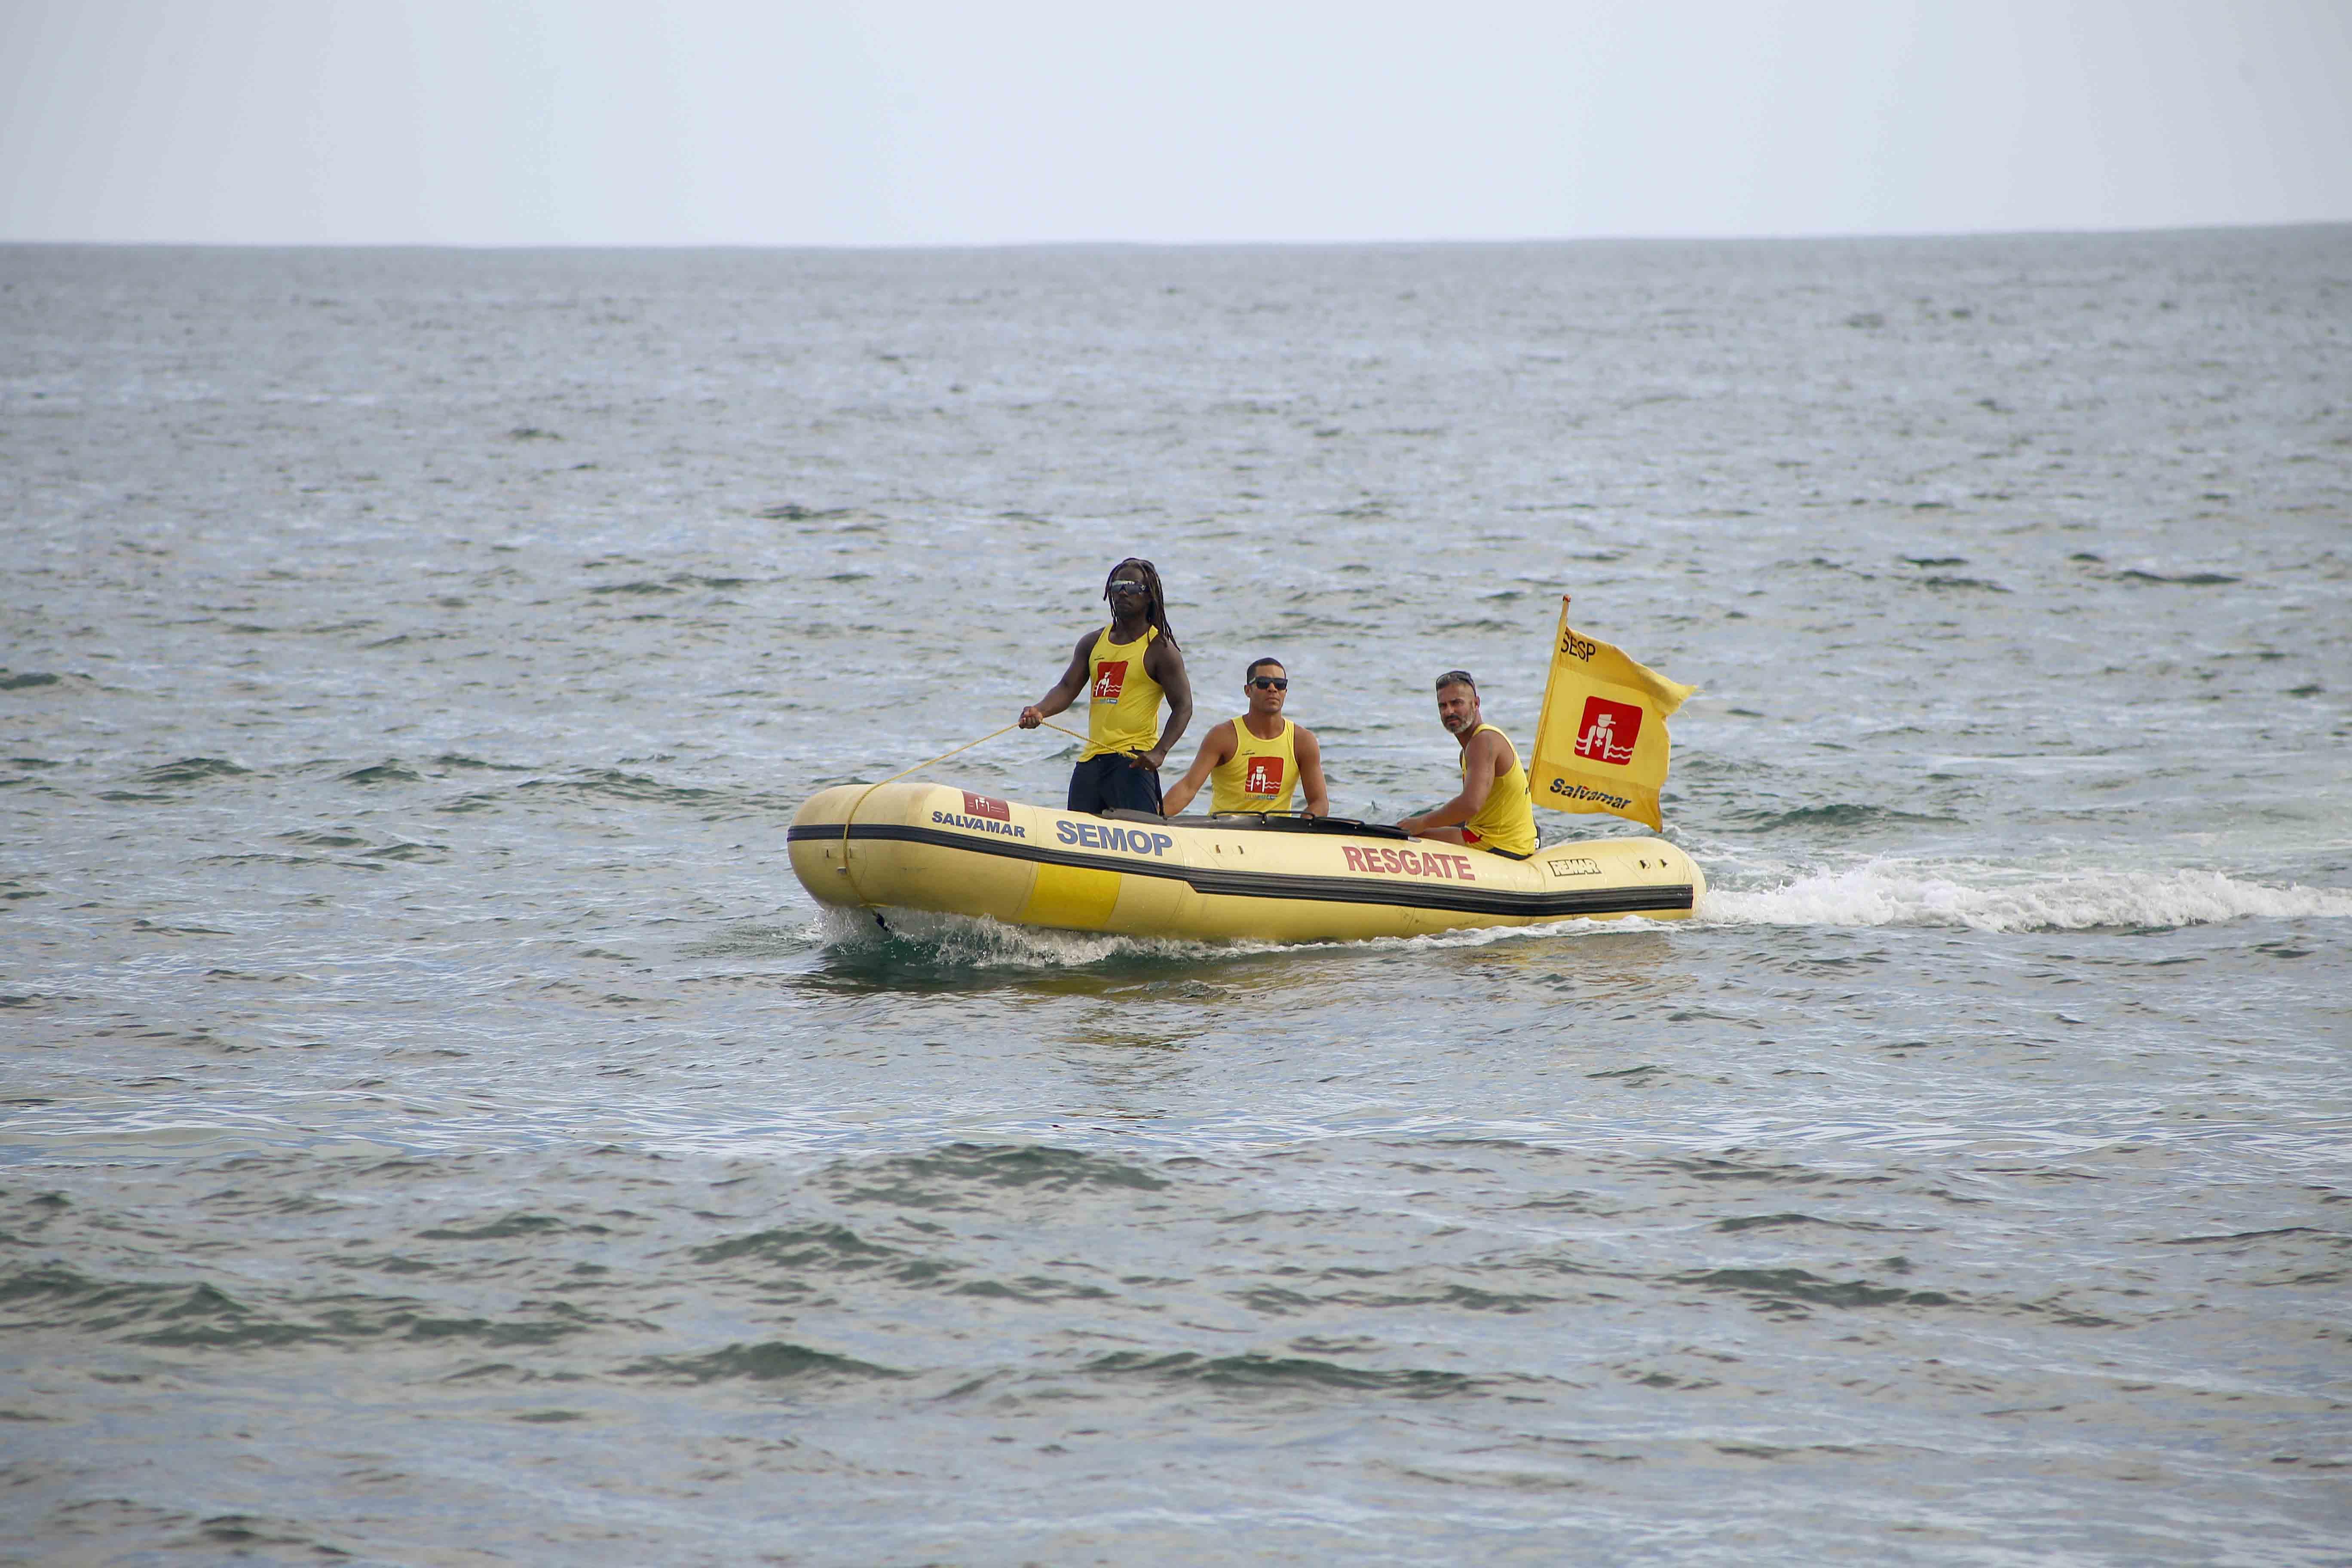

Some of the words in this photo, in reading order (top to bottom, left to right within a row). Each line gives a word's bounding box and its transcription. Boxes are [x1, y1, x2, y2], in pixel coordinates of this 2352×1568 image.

[1561, 631, 1596, 662] SESP
[1550, 778, 1632, 809] Salvamar
[931, 811, 1026, 838] SALVAMAR
[1056, 820, 1173, 856] SEMOP
[1341, 845, 1476, 881] RESGATE
[1547, 858, 1602, 877] REMAR
